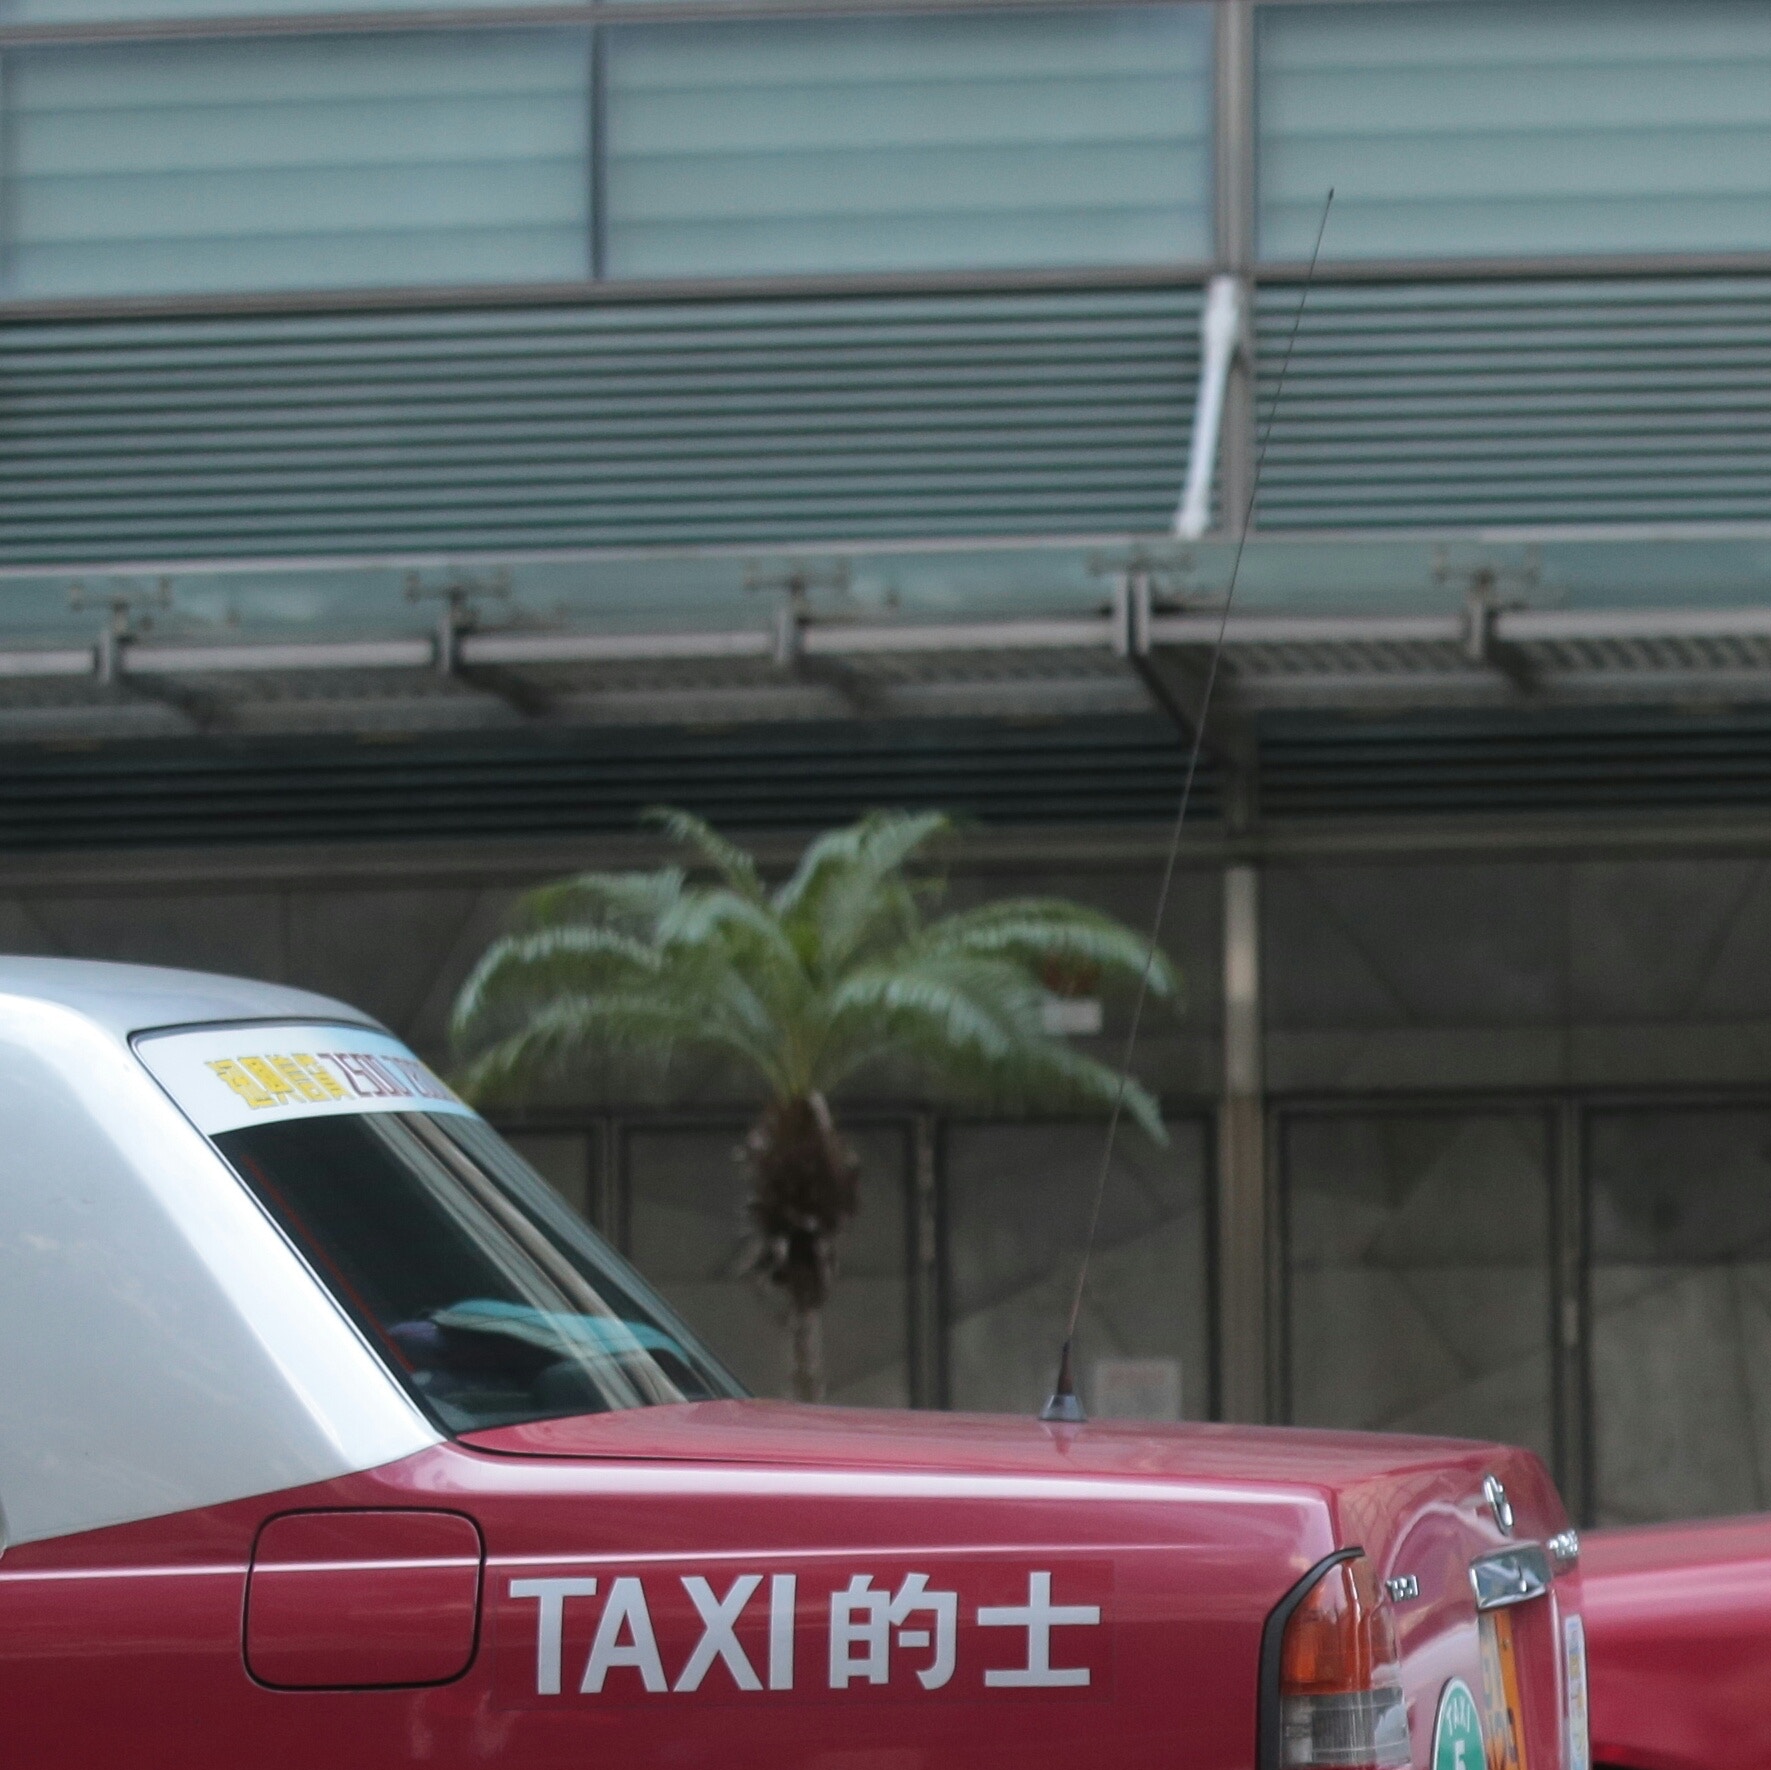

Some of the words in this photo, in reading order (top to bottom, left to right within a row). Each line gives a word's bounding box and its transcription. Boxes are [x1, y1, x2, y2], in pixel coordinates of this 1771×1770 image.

[509, 1574, 796, 1695] TAXI
[828, 1571, 1101, 1690] 的士
[1445, 1698, 1471, 1736] TAXI
